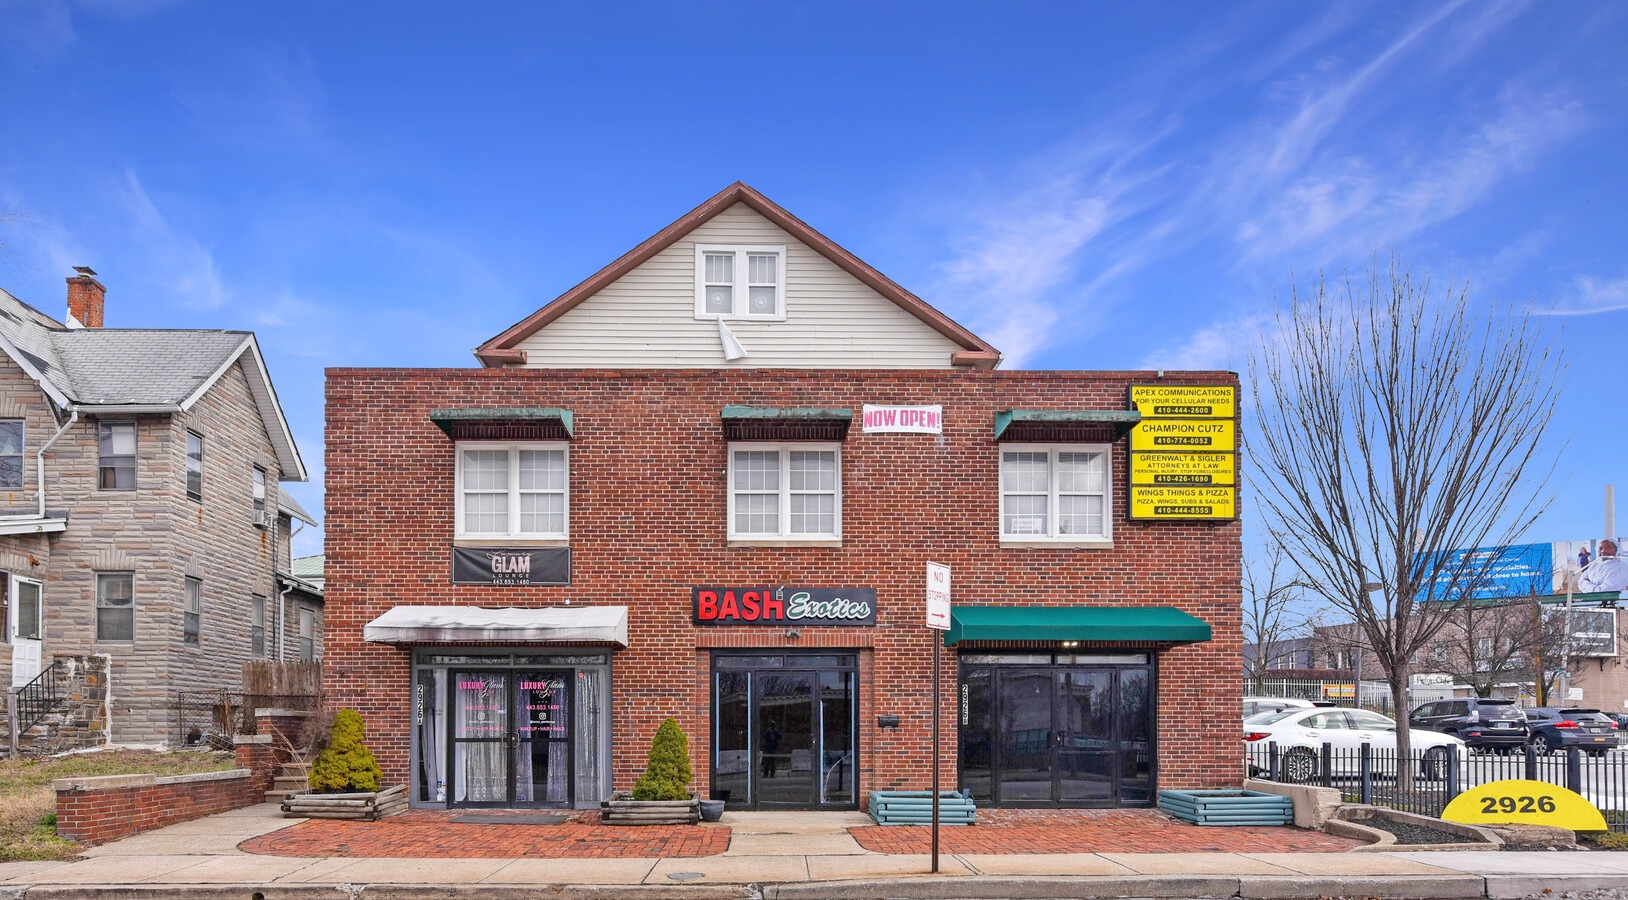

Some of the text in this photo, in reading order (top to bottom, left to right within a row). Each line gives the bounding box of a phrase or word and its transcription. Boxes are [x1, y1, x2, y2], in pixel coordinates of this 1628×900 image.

[864, 409, 941, 429] NOW OPEN!
[1142, 424, 1224, 433] CHAMPION CUTZ
[491, 556, 531, 573] GLAM
[934, 571, 944, 583] NO
[698, 589, 871, 621] BASH Exotics
[928, 590, 949, 603] STOPPING
[459, 681, 485, 690] LUXURY
[520, 679, 565, 698] LUXURY Glam
[1479, 795, 1557, 814] 2926
